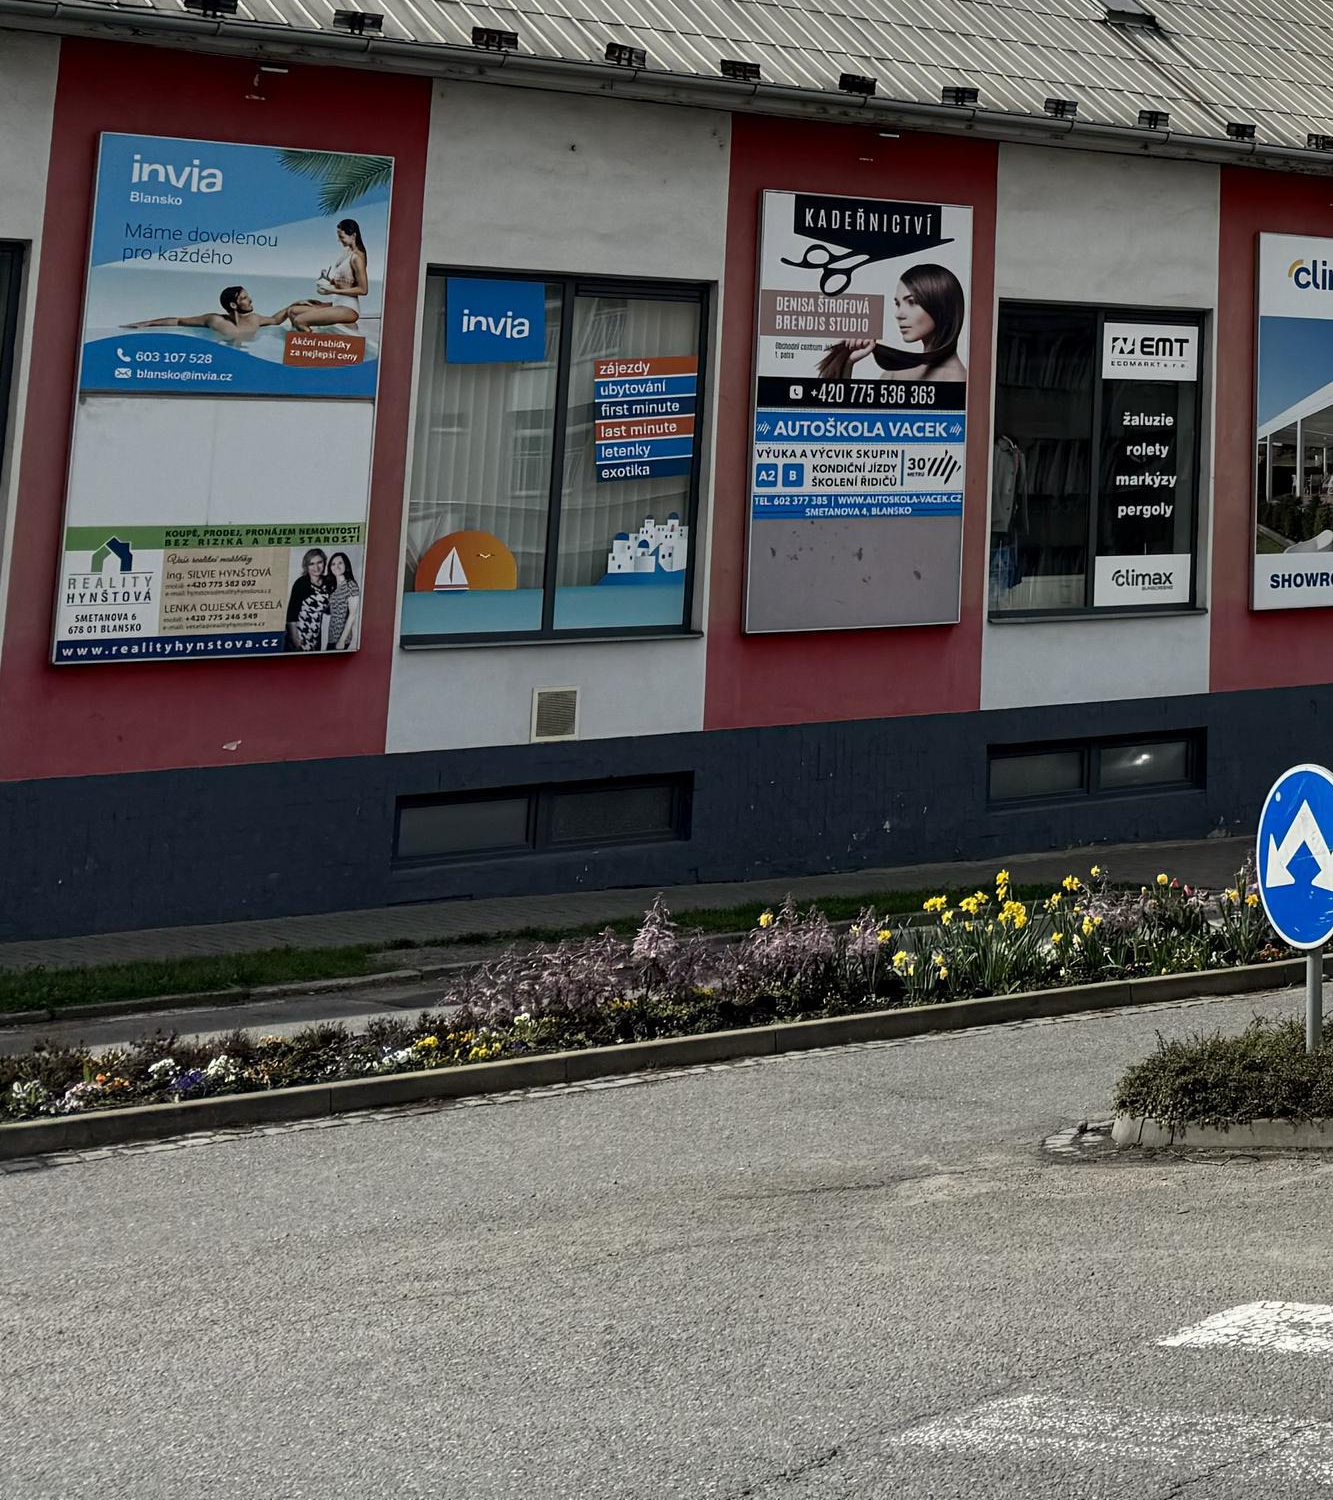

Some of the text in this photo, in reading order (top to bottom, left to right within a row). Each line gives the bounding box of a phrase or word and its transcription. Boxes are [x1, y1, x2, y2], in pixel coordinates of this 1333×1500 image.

[131, 154, 223, 192] invia
[130, 191, 182, 205] Blansko
[805, 208, 932, 235] KADEŘNICTVÍ
[125, 222, 278, 247] Máme dovolenou
[123, 247, 233, 265] pro každého
[776, 295, 869, 314] DENISA ŠTROFOVÁ
[462, 309, 530, 339] invia
[775, 315, 869, 332] BRENDIS STUDIO
[1140, 337, 1189, 357] EMT
[136, 352, 212, 364] 603 107 528
[337, 353, 357, 362] ceny
[137, 370, 233, 381] blansko@invia.cz
[599, 361, 650, 376] zájezdy
[600, 380, 666, 396] ubytování
[811, 384, 936, 404] +420 775 536 363
[601, 401, 680, 417] first minute
[1123, 412, 1174, 426] žaluzie
[601, 422, 677, 438] last minute
[773, 417, 947, 437] AUTOŠKOLA VACEK
[601, 444, 651, 458] letenky
[757, 447, 898, 458] VÝUKA A VÝCVIK SKUPIN
[1126, 443, 1169, 458] rolety
[602, 464, 650, 479] exotika
[812, 462, 897, 473] KONDIČNÍ JÍZDY
[908, 458, 926, 470] 30
[758, 470, 775, 481] A2
[789, 471, 797, 480] B
[812, 475, 897, 487] ŠKOLENÍ ŘIDIČŮ
[1116, 472, 1177, 487] markýzy
[755, 497, 772, 505] TEL.
[805, 507, 912, 516] SMETANOVA 4, BLANSKO
[1117, 502, 1173, 518] pergoly
[198, 538, 243, 546] RIZIKA
[300, 535, 360, 544] STAROSTÍ
[167, 567, 271, 581] Ing. SILVIE HYNŠTOVÁ
[1112, 569, 1173, 587] climax
[68, 576, 152, 589] REALITY
[67, 588, 151, 604] HYNŠTOVÁ
[165, 604, 197, 613] LENKA
[247, 600, 282, 610] VESELÁ
[75, 613, 128, 622] SMETANOVA
[68, 626, 83, 634] 678
[101, 623, 141, 633] BLANSKO
[62, 638, 279, 657] www.realityhynstova.cz
